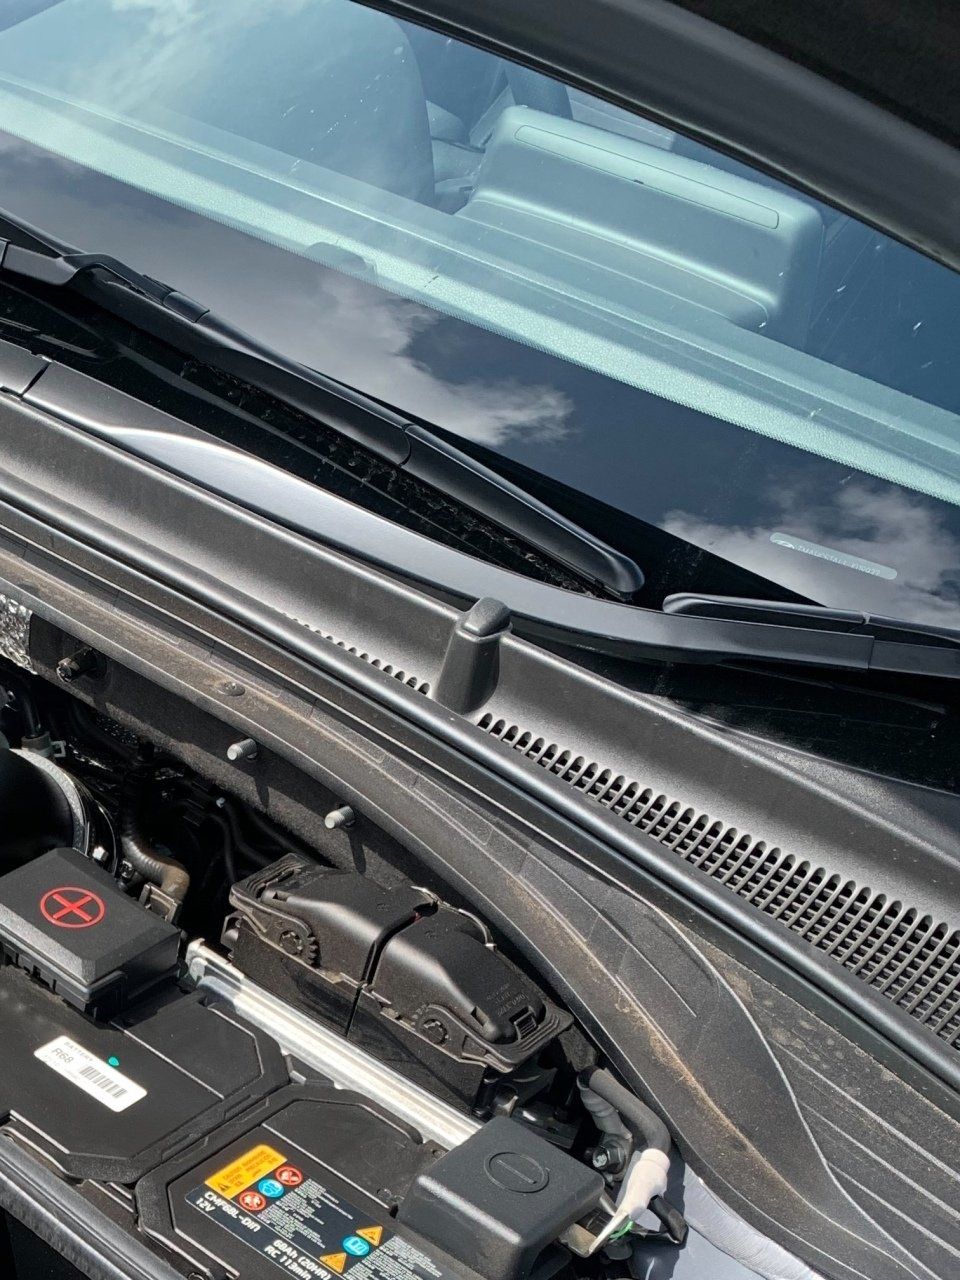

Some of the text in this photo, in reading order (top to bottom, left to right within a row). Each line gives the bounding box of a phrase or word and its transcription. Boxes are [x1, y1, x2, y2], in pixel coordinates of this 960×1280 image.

[51, 1047, 74, 1064] R68
[196, 1199, 215, 1213] 12V
[264, 1245, 280, 1259] RC
